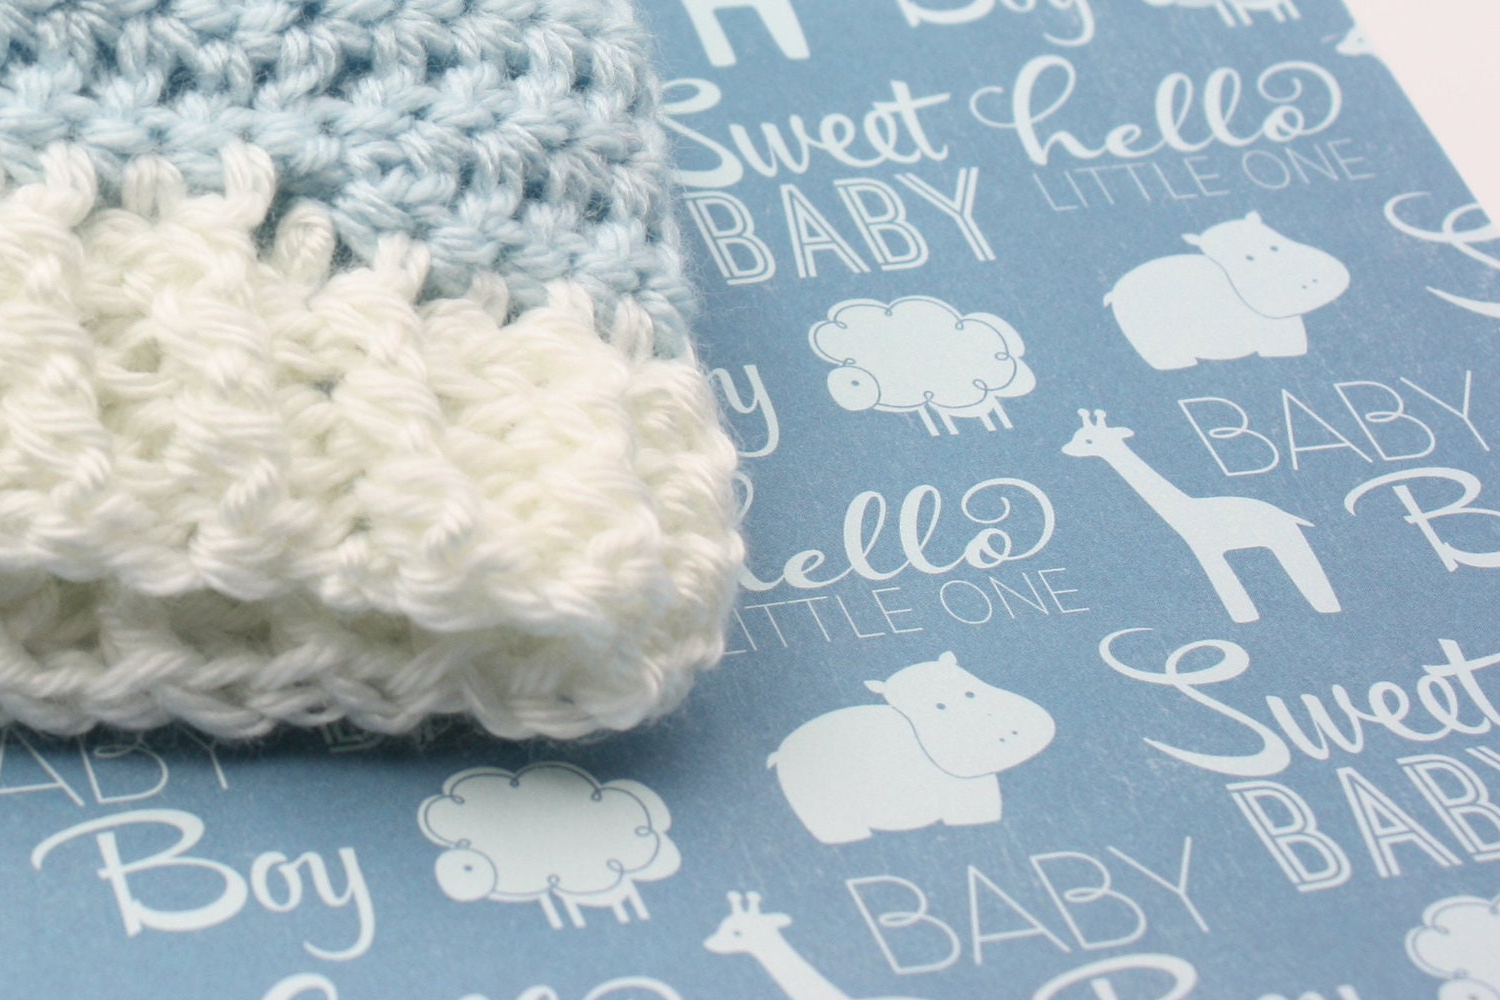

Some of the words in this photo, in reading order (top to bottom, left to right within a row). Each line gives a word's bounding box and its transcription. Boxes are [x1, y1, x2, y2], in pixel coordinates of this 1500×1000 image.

[655, 77, 952, 190] Sweet
[968, 54, 1343, 167] hello
[680, 165, 996, 287] BABY
[1032, 155, 1232, 213] LITTLE
[1240, 136, 1378, 191] ONE
[1177, 369, 1491, 477] BABY
[735, 470, 1056, 593] ello
[722, 586, 925, 656] ITTLE
[938, 567, 1092, 626] ONE
[1099, 626, 1500, 777] Sweet
[1225, 744, 1500, 893] BAB
[30, 807, 376, 961] Boy
[844, 835, 1211, 975] BABY
